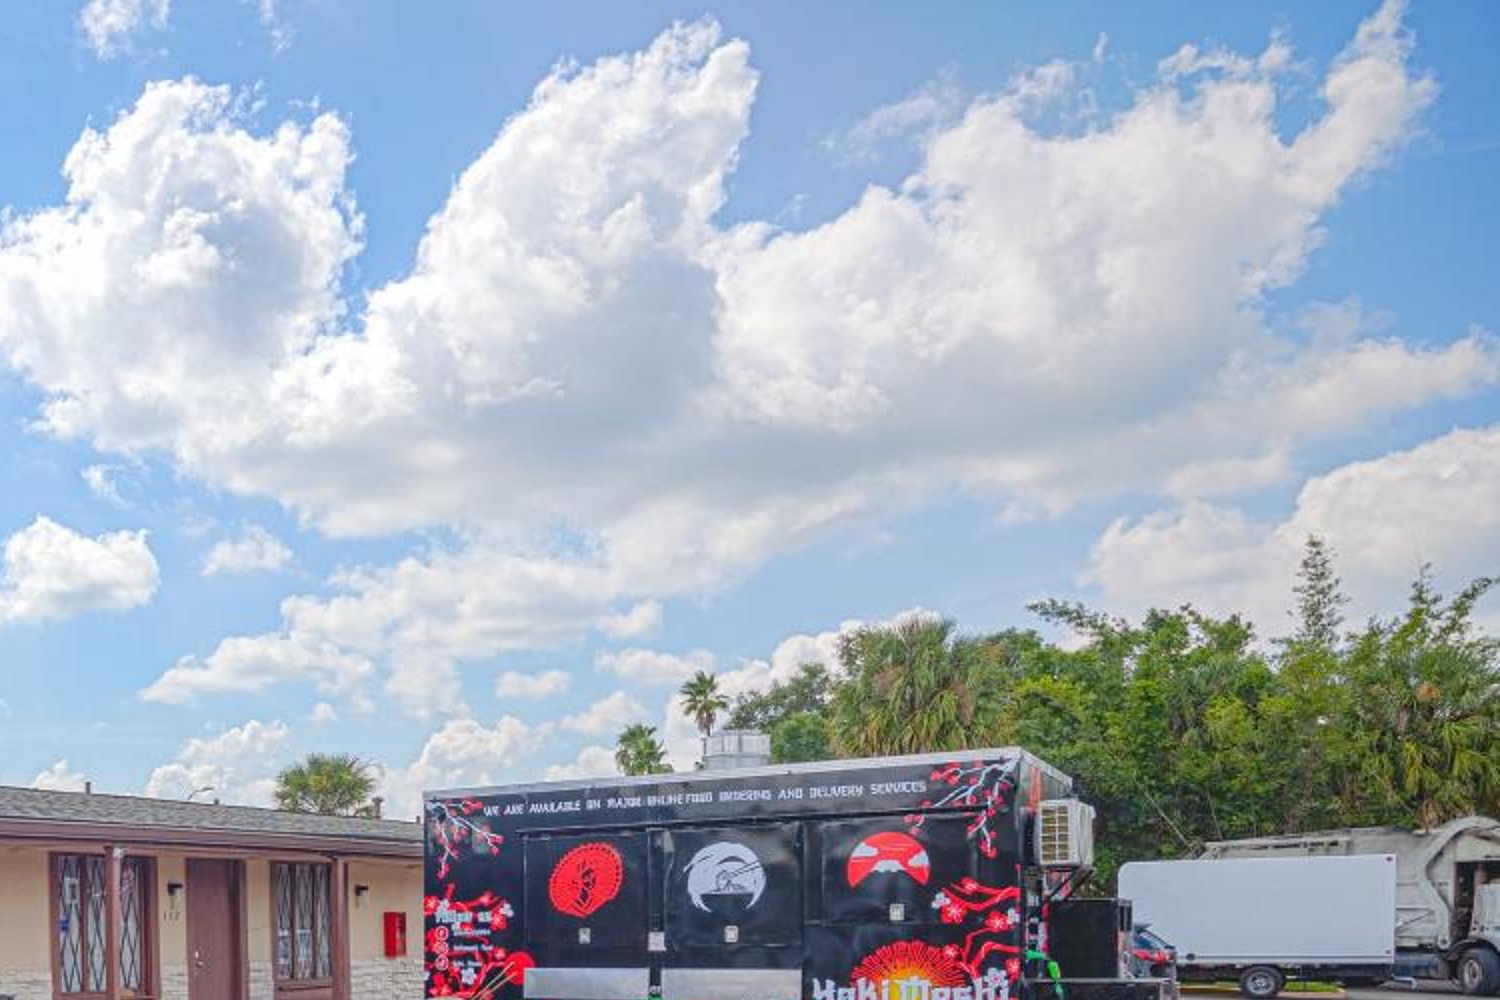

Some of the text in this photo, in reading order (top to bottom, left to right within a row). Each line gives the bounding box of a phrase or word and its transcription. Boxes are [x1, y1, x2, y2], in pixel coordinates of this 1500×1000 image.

[483, 805, 500, 817] WE
[504, 803, 524, 815] ARE
[529, 800, 581, 814] AVAILABLE
[607, 797, 642, 809] MAJOR
[647, 794, 684, 807] ONLINE
[685, 792, 713, 804] FOOD
[719, 790, 771, 801] ORDERING
[778, 787, 803, 799] AND
[809, 785, 863, 798] DELIVERY
[870, 780, 927, 796] SERVICES
